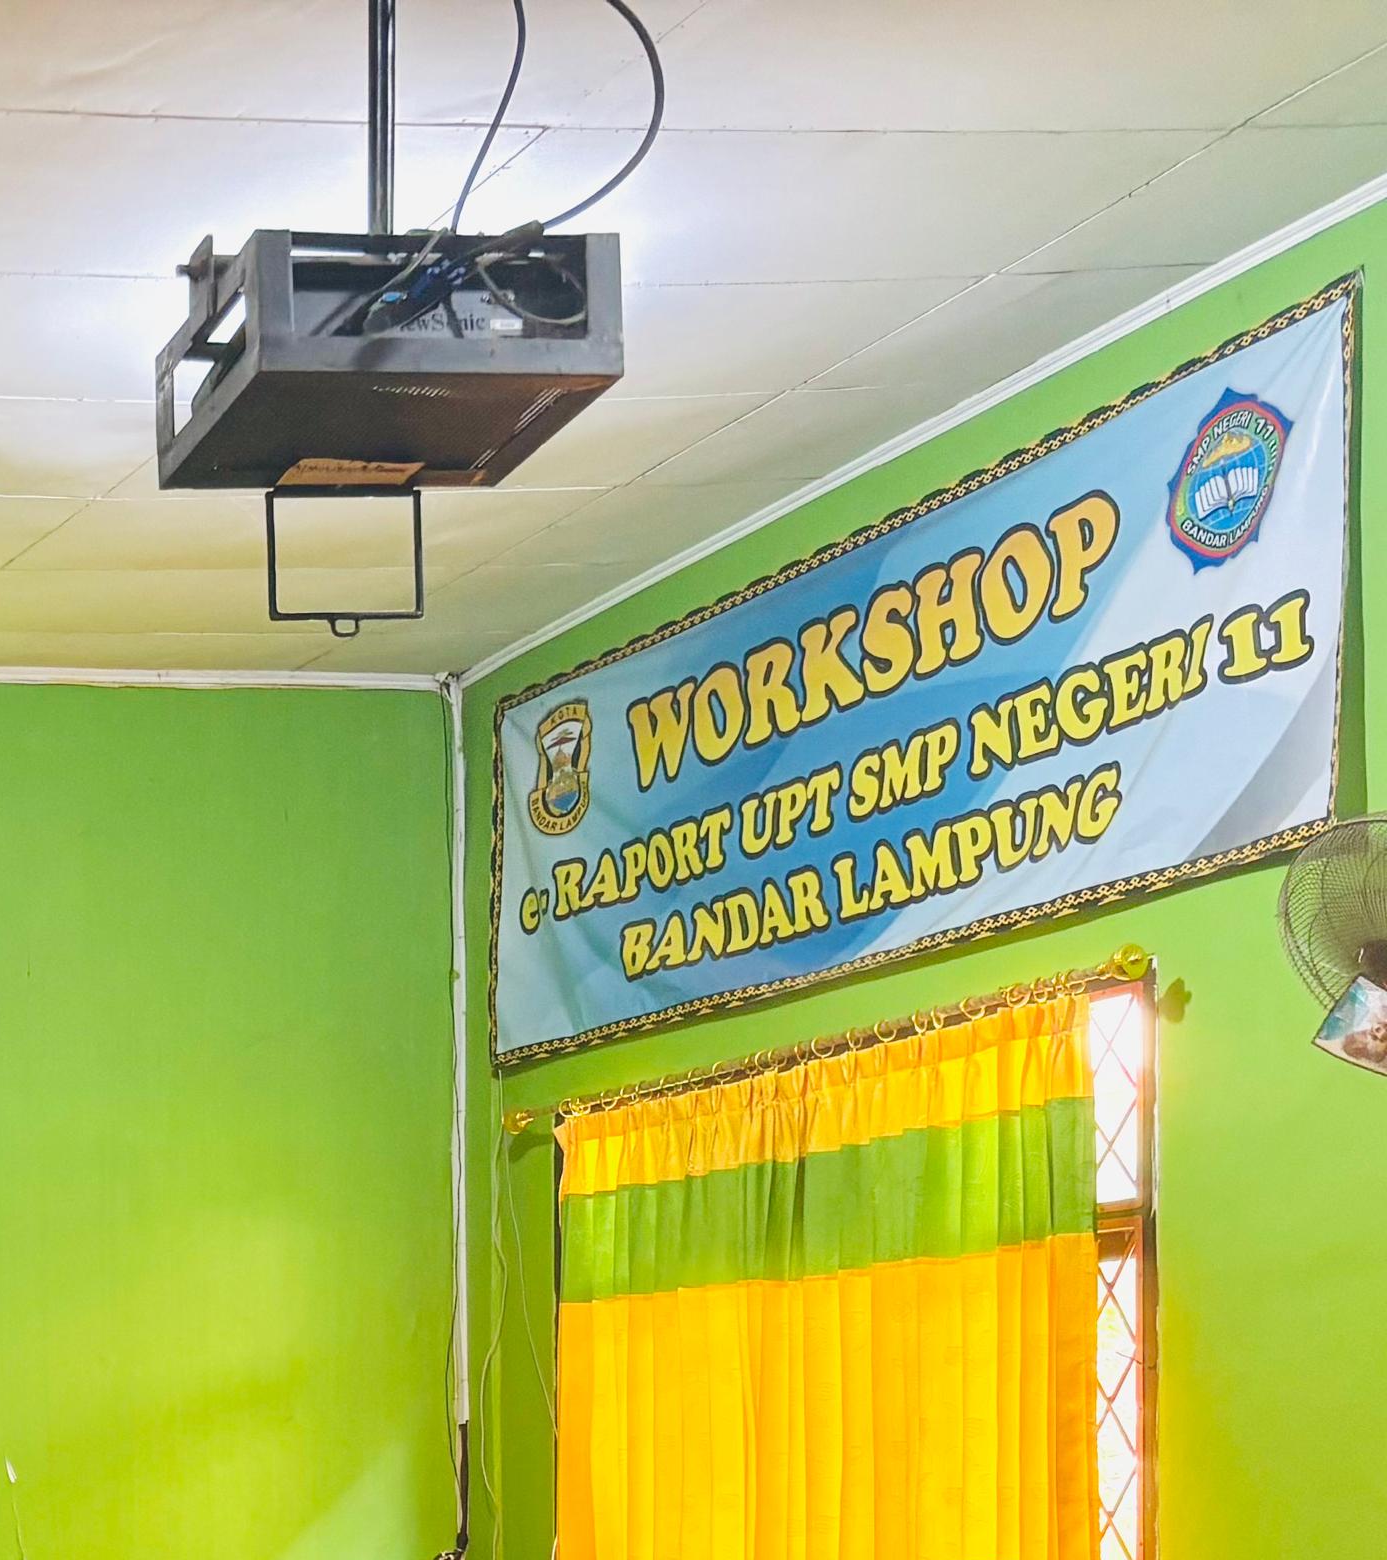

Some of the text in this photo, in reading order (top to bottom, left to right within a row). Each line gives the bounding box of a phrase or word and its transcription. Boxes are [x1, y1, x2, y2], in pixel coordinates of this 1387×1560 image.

[1187, 410, 1275, 475] SMP NEGERI 11
[1182, 519, 1228, 548] BANDAR
[628, 489, 1120, 791] WORKSHOP
[550, 706, 579, 725] KOTA
[553, 806, 731, 919] RAPORT
[739, 762, 843, 859] UPT
[848, 722, 958, 820] SMP
[969, 613, 1214, 784] NEGERI
[1218, 588, 1315, 684] 11
[531, 797, 558, 832] BANDAR
[621, 762, 1122, 981] BANDAR LAMPUNG
